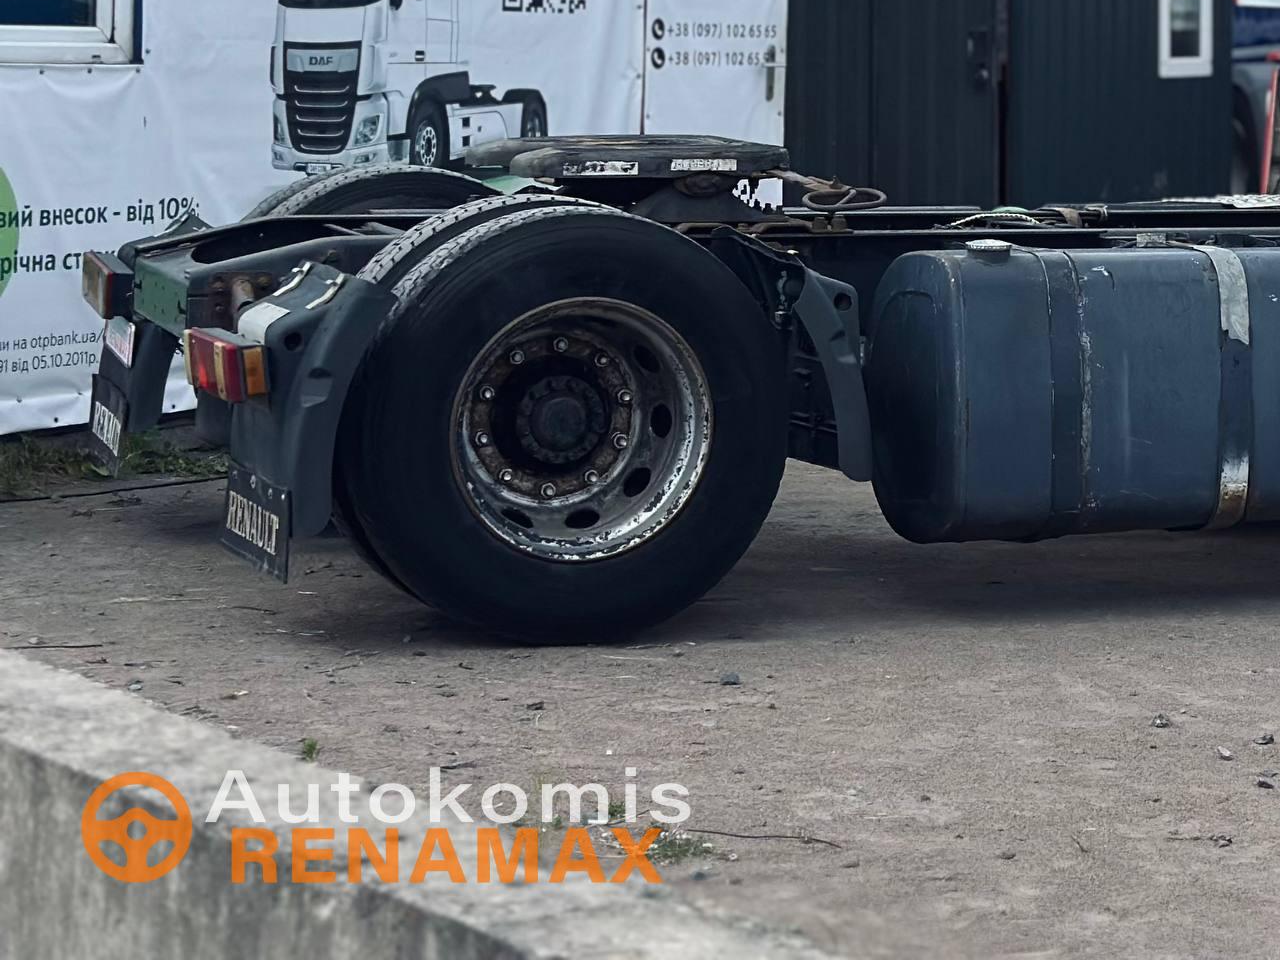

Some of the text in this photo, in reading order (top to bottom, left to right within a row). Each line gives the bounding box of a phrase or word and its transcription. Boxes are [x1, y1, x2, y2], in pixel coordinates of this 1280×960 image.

[667, 22, 689, 38] +38
[692, 22, 722, 39] (097)
[726, 23, 746, 38] 102
[308, 56, 333, 66] DAF
[667, 50, 689, 65] +38
[693, 50, 722, 67] (097)
[725, 52, 745, 66] 102
[39, 206, 108, 227] внесок
[127, 199, 154, 224] від
[13, 339, 27, 350] на
[11, 358, 29, 374] від
[32, 351, 98, 370] 05.10.2011р.
[227, 491, 279, 556] RENAULT
